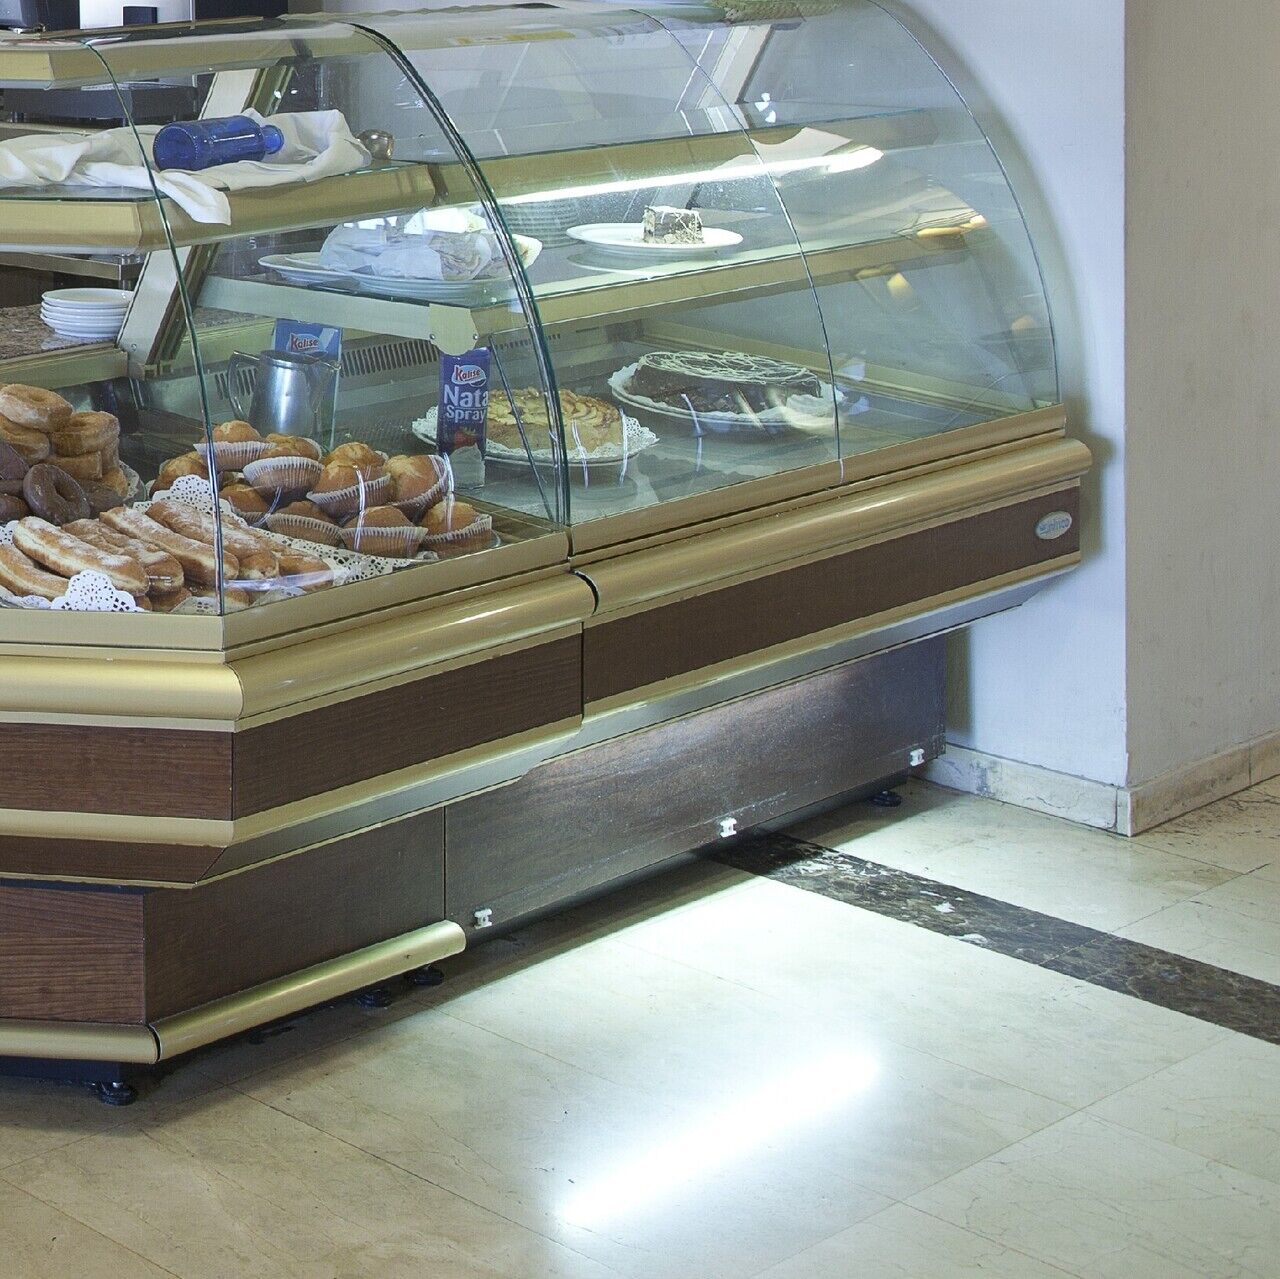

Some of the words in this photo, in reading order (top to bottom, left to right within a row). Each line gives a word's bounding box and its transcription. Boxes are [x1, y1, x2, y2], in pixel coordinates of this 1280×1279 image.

[290, 334, 319, 350] Kalise
[455, 366, 481, 382] Kalise
[443, 384, 489, 408] Nata
[446, 405, 486, 423] Spray
